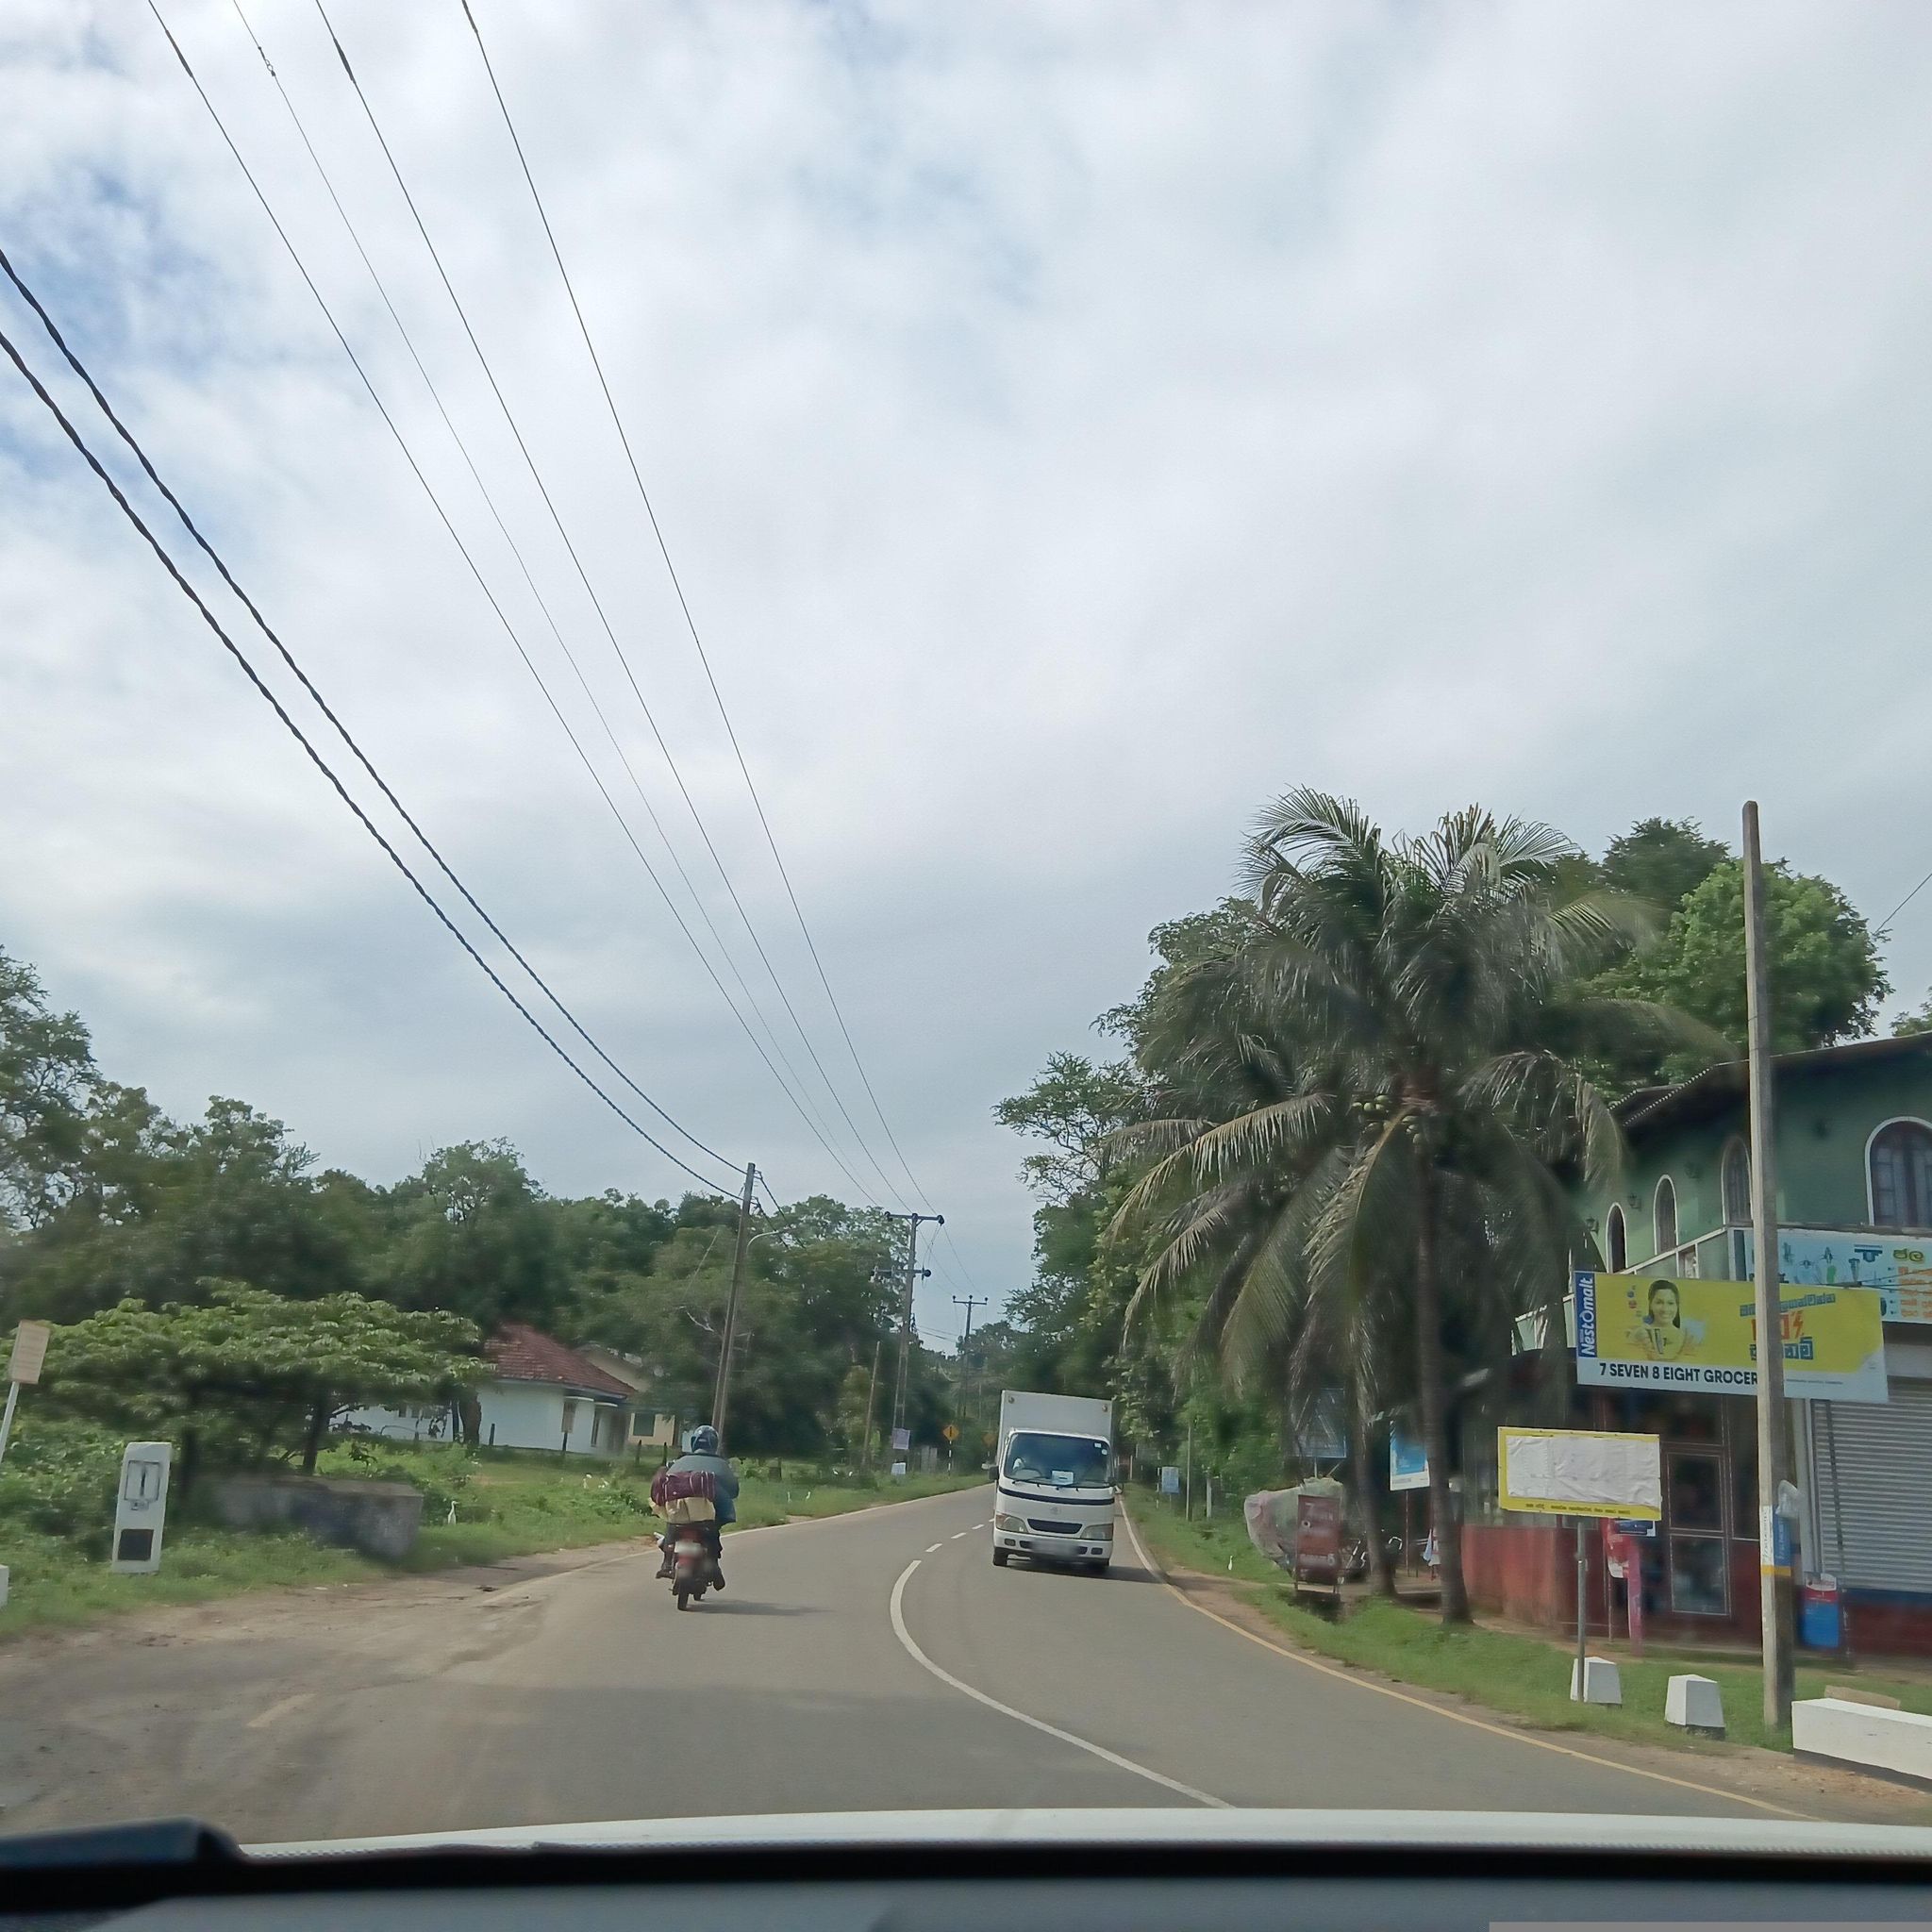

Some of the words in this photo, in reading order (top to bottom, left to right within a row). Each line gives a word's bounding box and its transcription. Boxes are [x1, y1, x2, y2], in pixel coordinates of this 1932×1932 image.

[1599, 1362, 1607, 1376] 7
[1609, 1363, 1649, 1379] SEVEN
[1652, 1366, 1660, 1379] 8
[1663, 1366, 1701, 1383] EIGHT
[1704, 1369, 1757, 1386] GROCER
